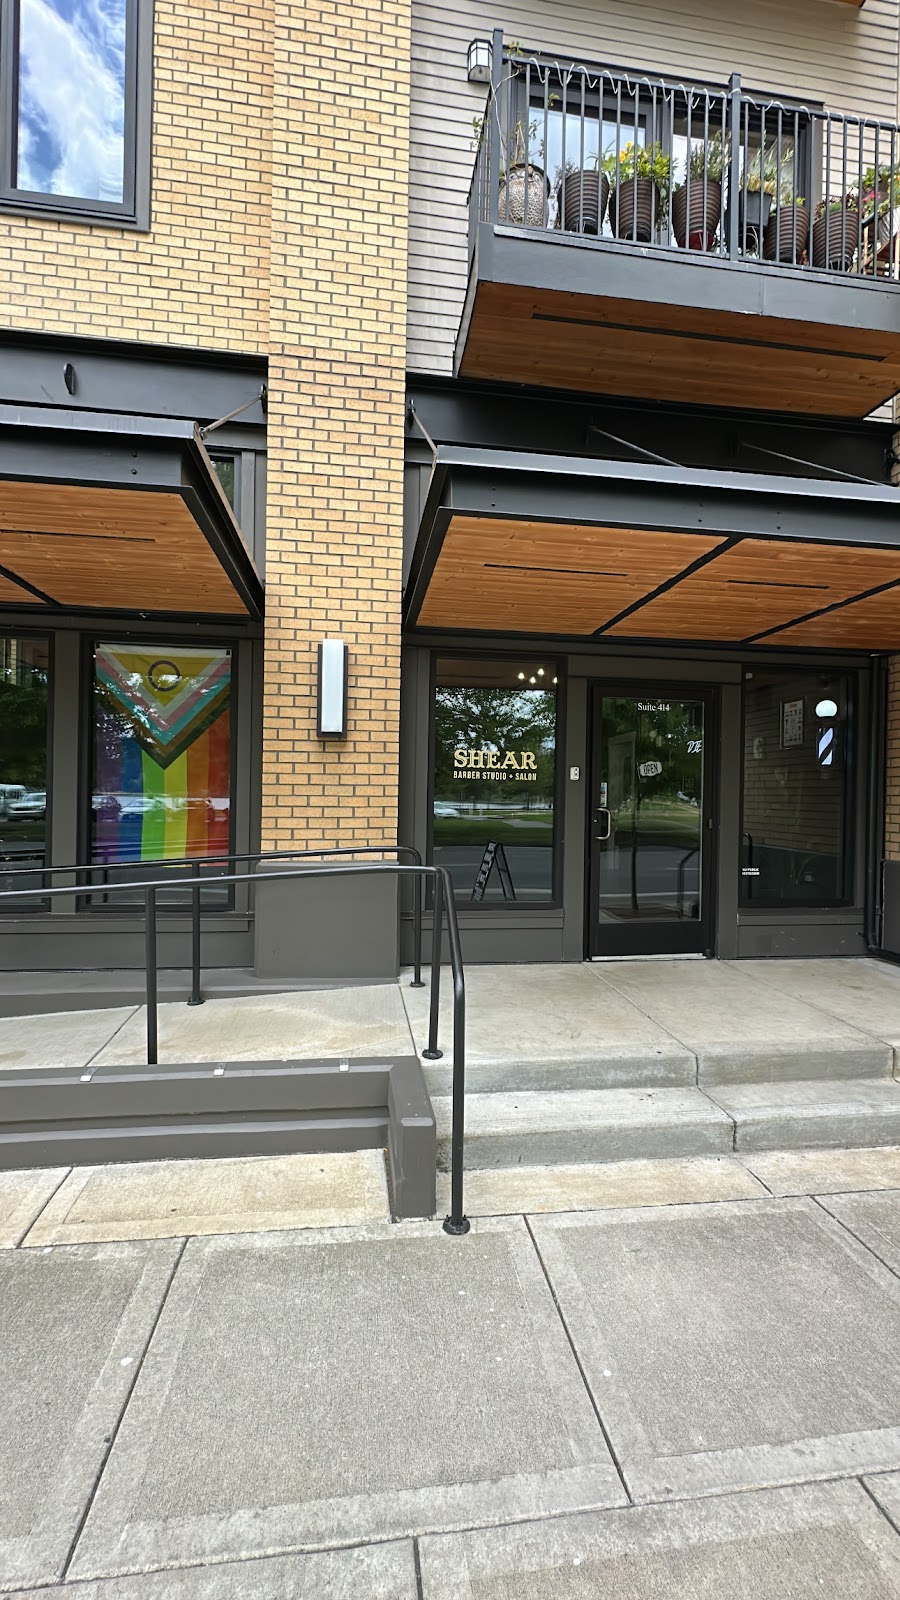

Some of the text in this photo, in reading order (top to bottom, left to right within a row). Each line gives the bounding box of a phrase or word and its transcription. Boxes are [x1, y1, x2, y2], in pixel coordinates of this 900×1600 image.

[637, 702, 670, 711] Suite 414
[454, 749, 537, 770] SHEAR
[643, 763, 659, 775] OPEN
[453, 770, 480, 779] BARBER
[482, 771, 507, 780] STUDIO
[515, 772, 537, 781] SALON
